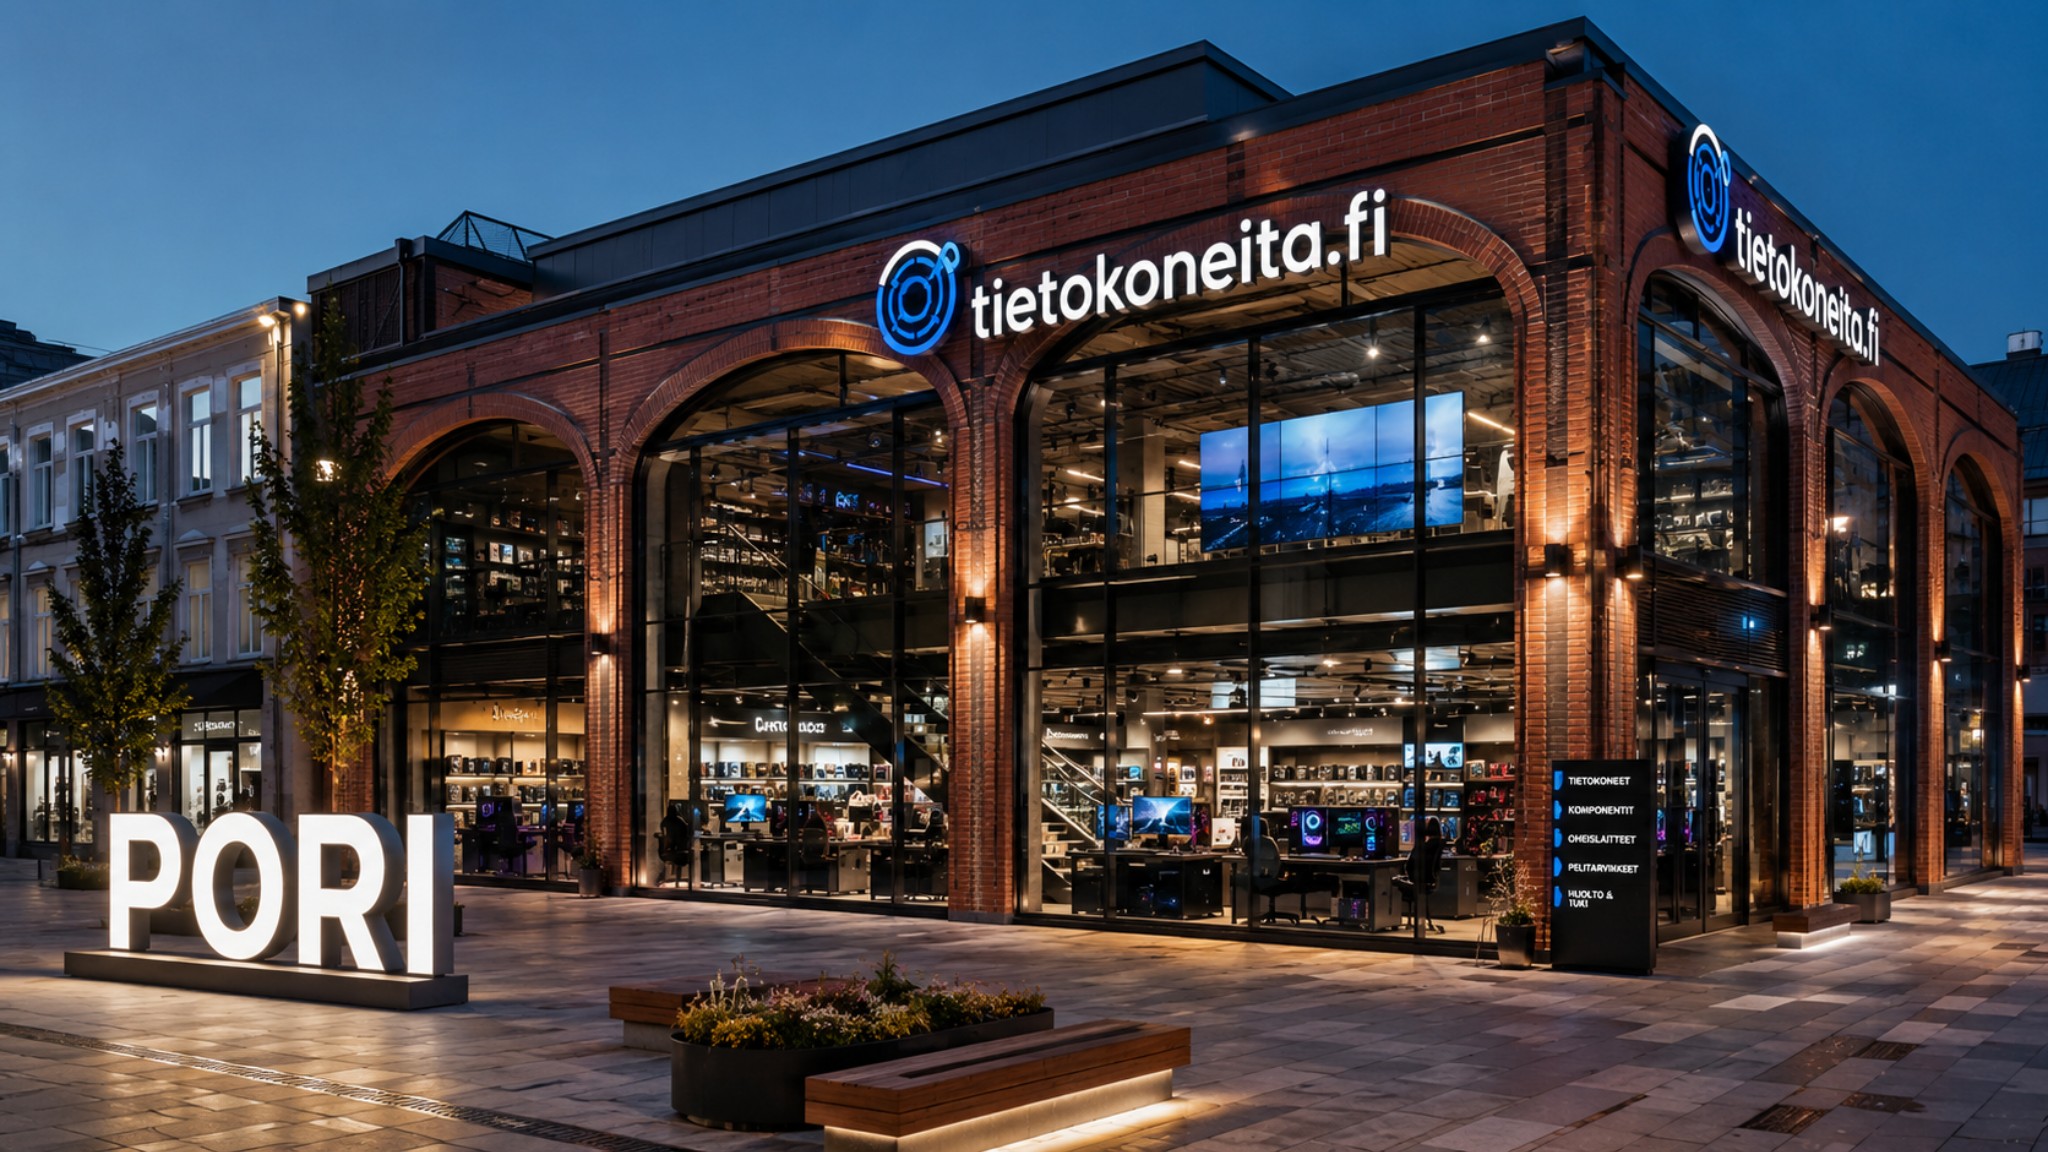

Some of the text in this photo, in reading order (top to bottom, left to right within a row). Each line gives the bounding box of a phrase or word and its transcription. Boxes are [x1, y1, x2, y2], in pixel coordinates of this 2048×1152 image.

[971, 188, 1386, 339] tietokoneita.fi
[1735, 207, 1879, 366] tietokoneita.fi
[1568, 776, 1631, 786] TIETOKONEET
[109, 812, 434, 976] PORI
[1568, 889, 1604, 899] HUOLTO
